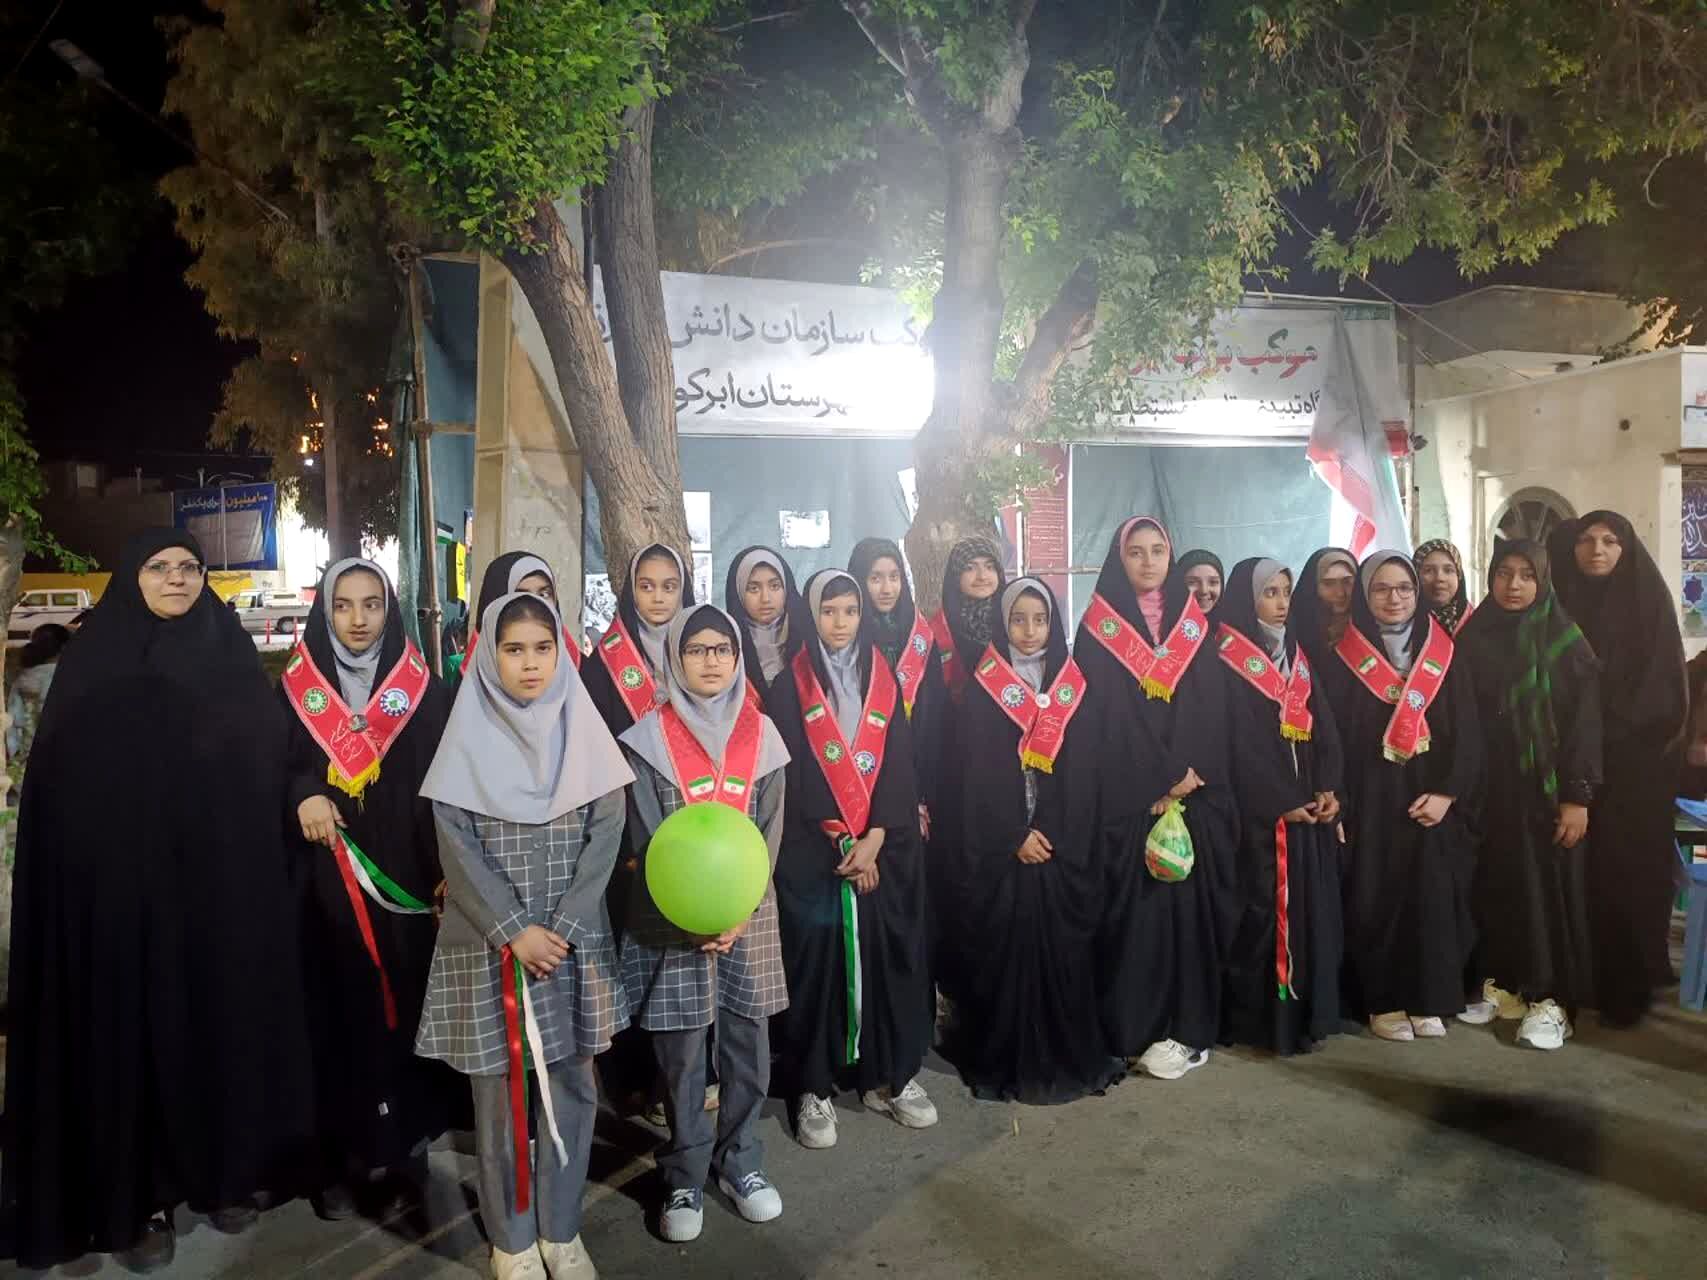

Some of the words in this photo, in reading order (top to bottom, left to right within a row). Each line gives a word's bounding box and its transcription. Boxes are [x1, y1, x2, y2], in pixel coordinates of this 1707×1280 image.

[671, 302, 756, 348] دانش
[761, 308, 865, 356] سازمان
[674, 367, 735, 415] ابرکو
